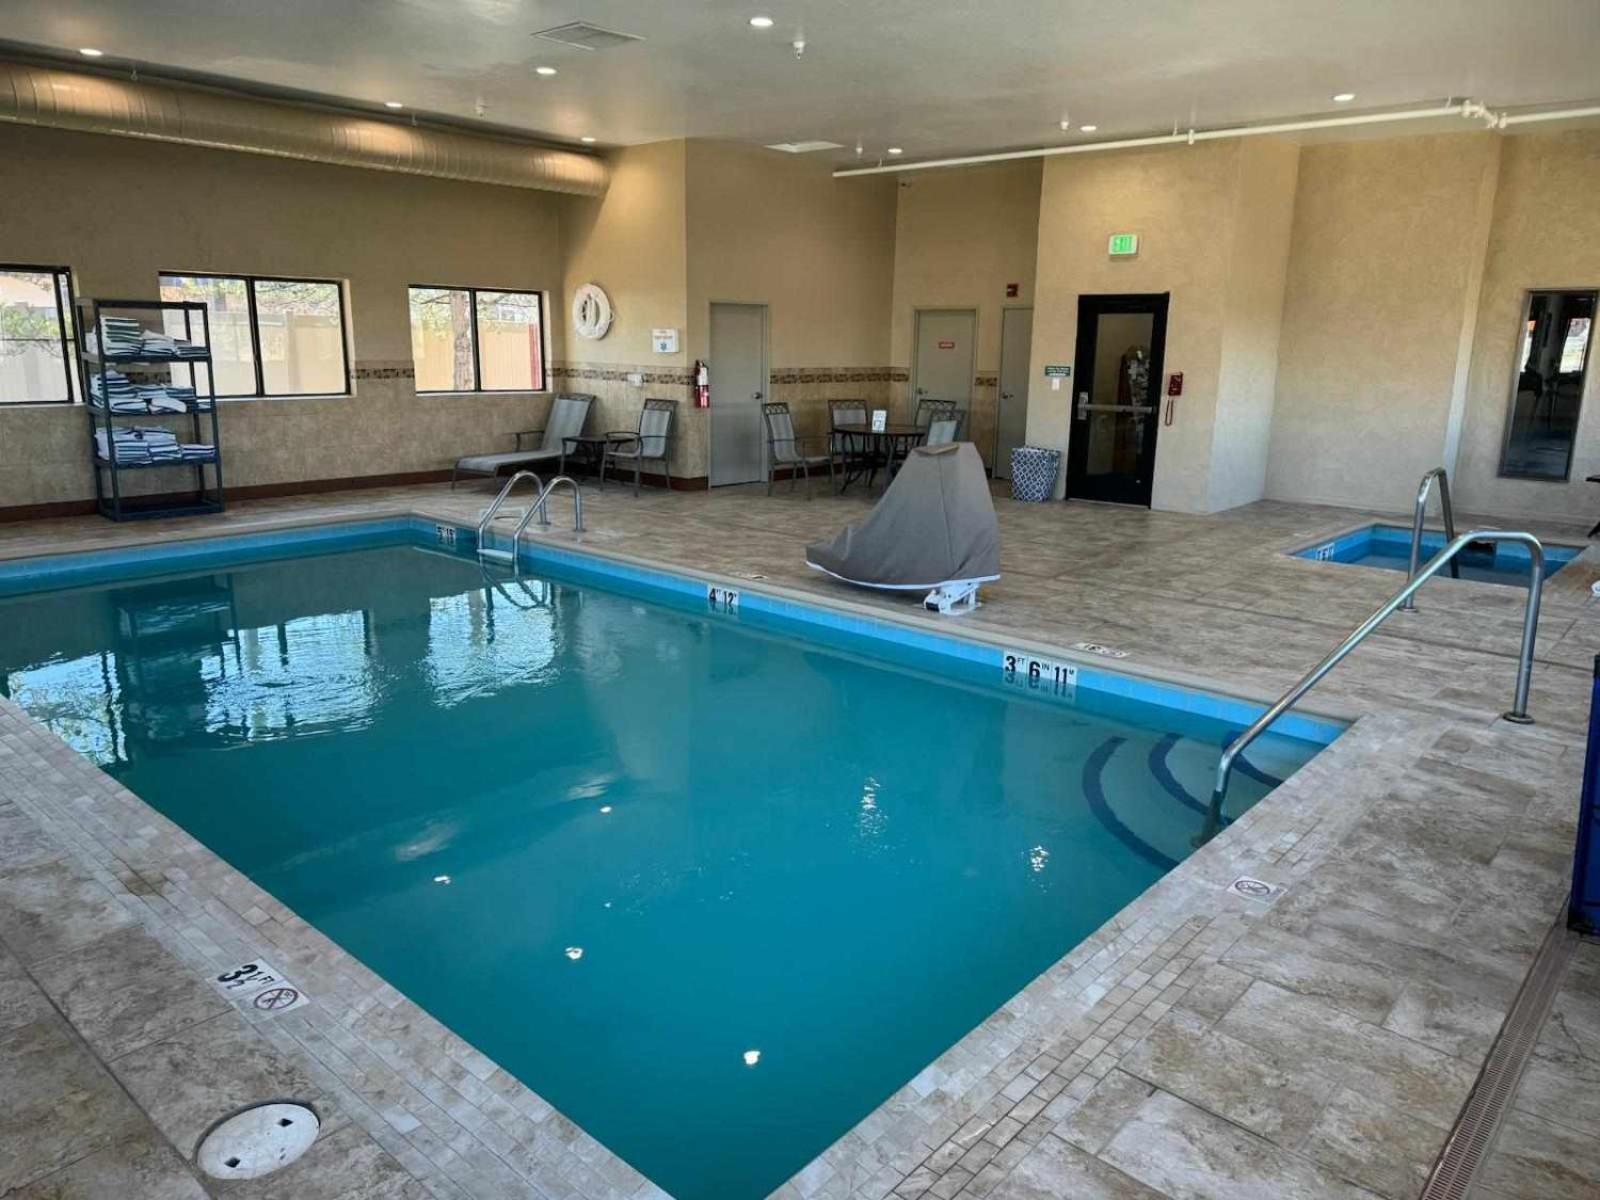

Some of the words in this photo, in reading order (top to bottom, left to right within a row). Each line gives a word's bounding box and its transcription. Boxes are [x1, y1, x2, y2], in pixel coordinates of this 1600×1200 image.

[1112, 236, 1132, 253] EXIT
[709, 587, 716, 600] 4
[1005, 655, 1016, 673] 3
[1028, 661, 1041, 678] 6
[218, 963, 258, 982] 3
